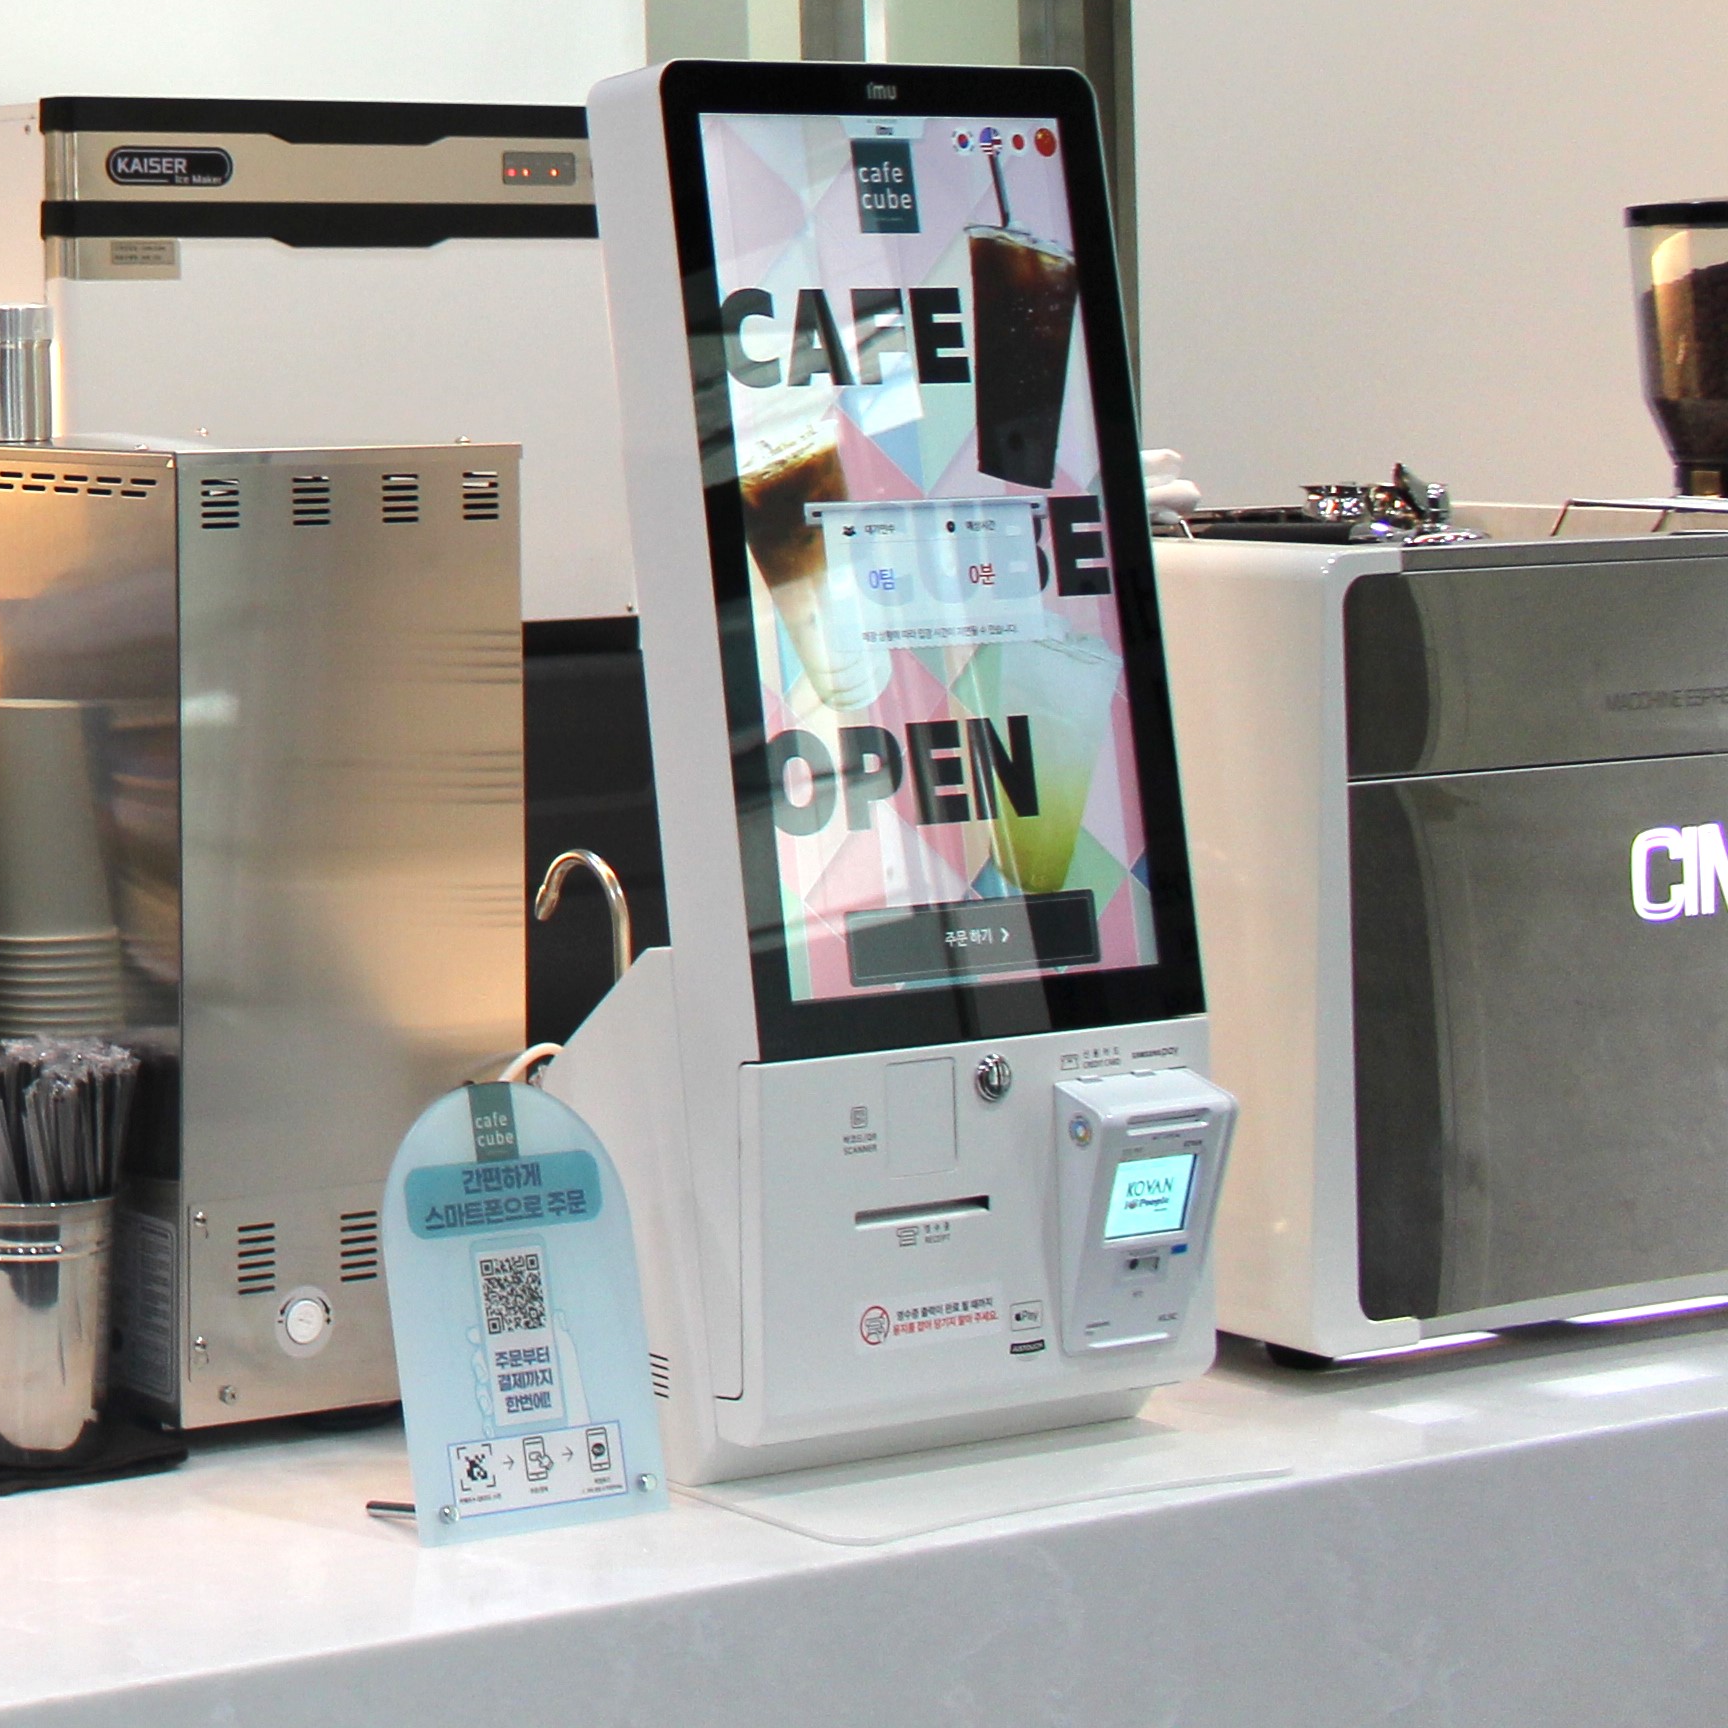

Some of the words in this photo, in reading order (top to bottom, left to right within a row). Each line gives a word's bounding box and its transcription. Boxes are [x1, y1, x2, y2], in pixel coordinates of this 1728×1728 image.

[117, 157, 187, 174] KAISER
[858, 161, 904, 183] cafe
[192, 175, 222, 184] Maker
[861, 188, 912, 209] cube
[721, 288, 971, 388] CAFE
[969, 562, 996, 586] 0분
[767, 714, 1041, 837] OPEN
[475, 1112, 508, 1129] cafe
[477, 1131, 515, 1147] cube
[462, 1163, 542, 1195] 간편하게
[1126, 1177, 1174, 1197] KOVAN
[425, 1194, 544, 1231] 스마트폰으로
[547, 1188, 588, 1217] 주문
[495, 1345, 551, 1369] 주문부터
[497, 1367, 554, 1392] 결제까지
